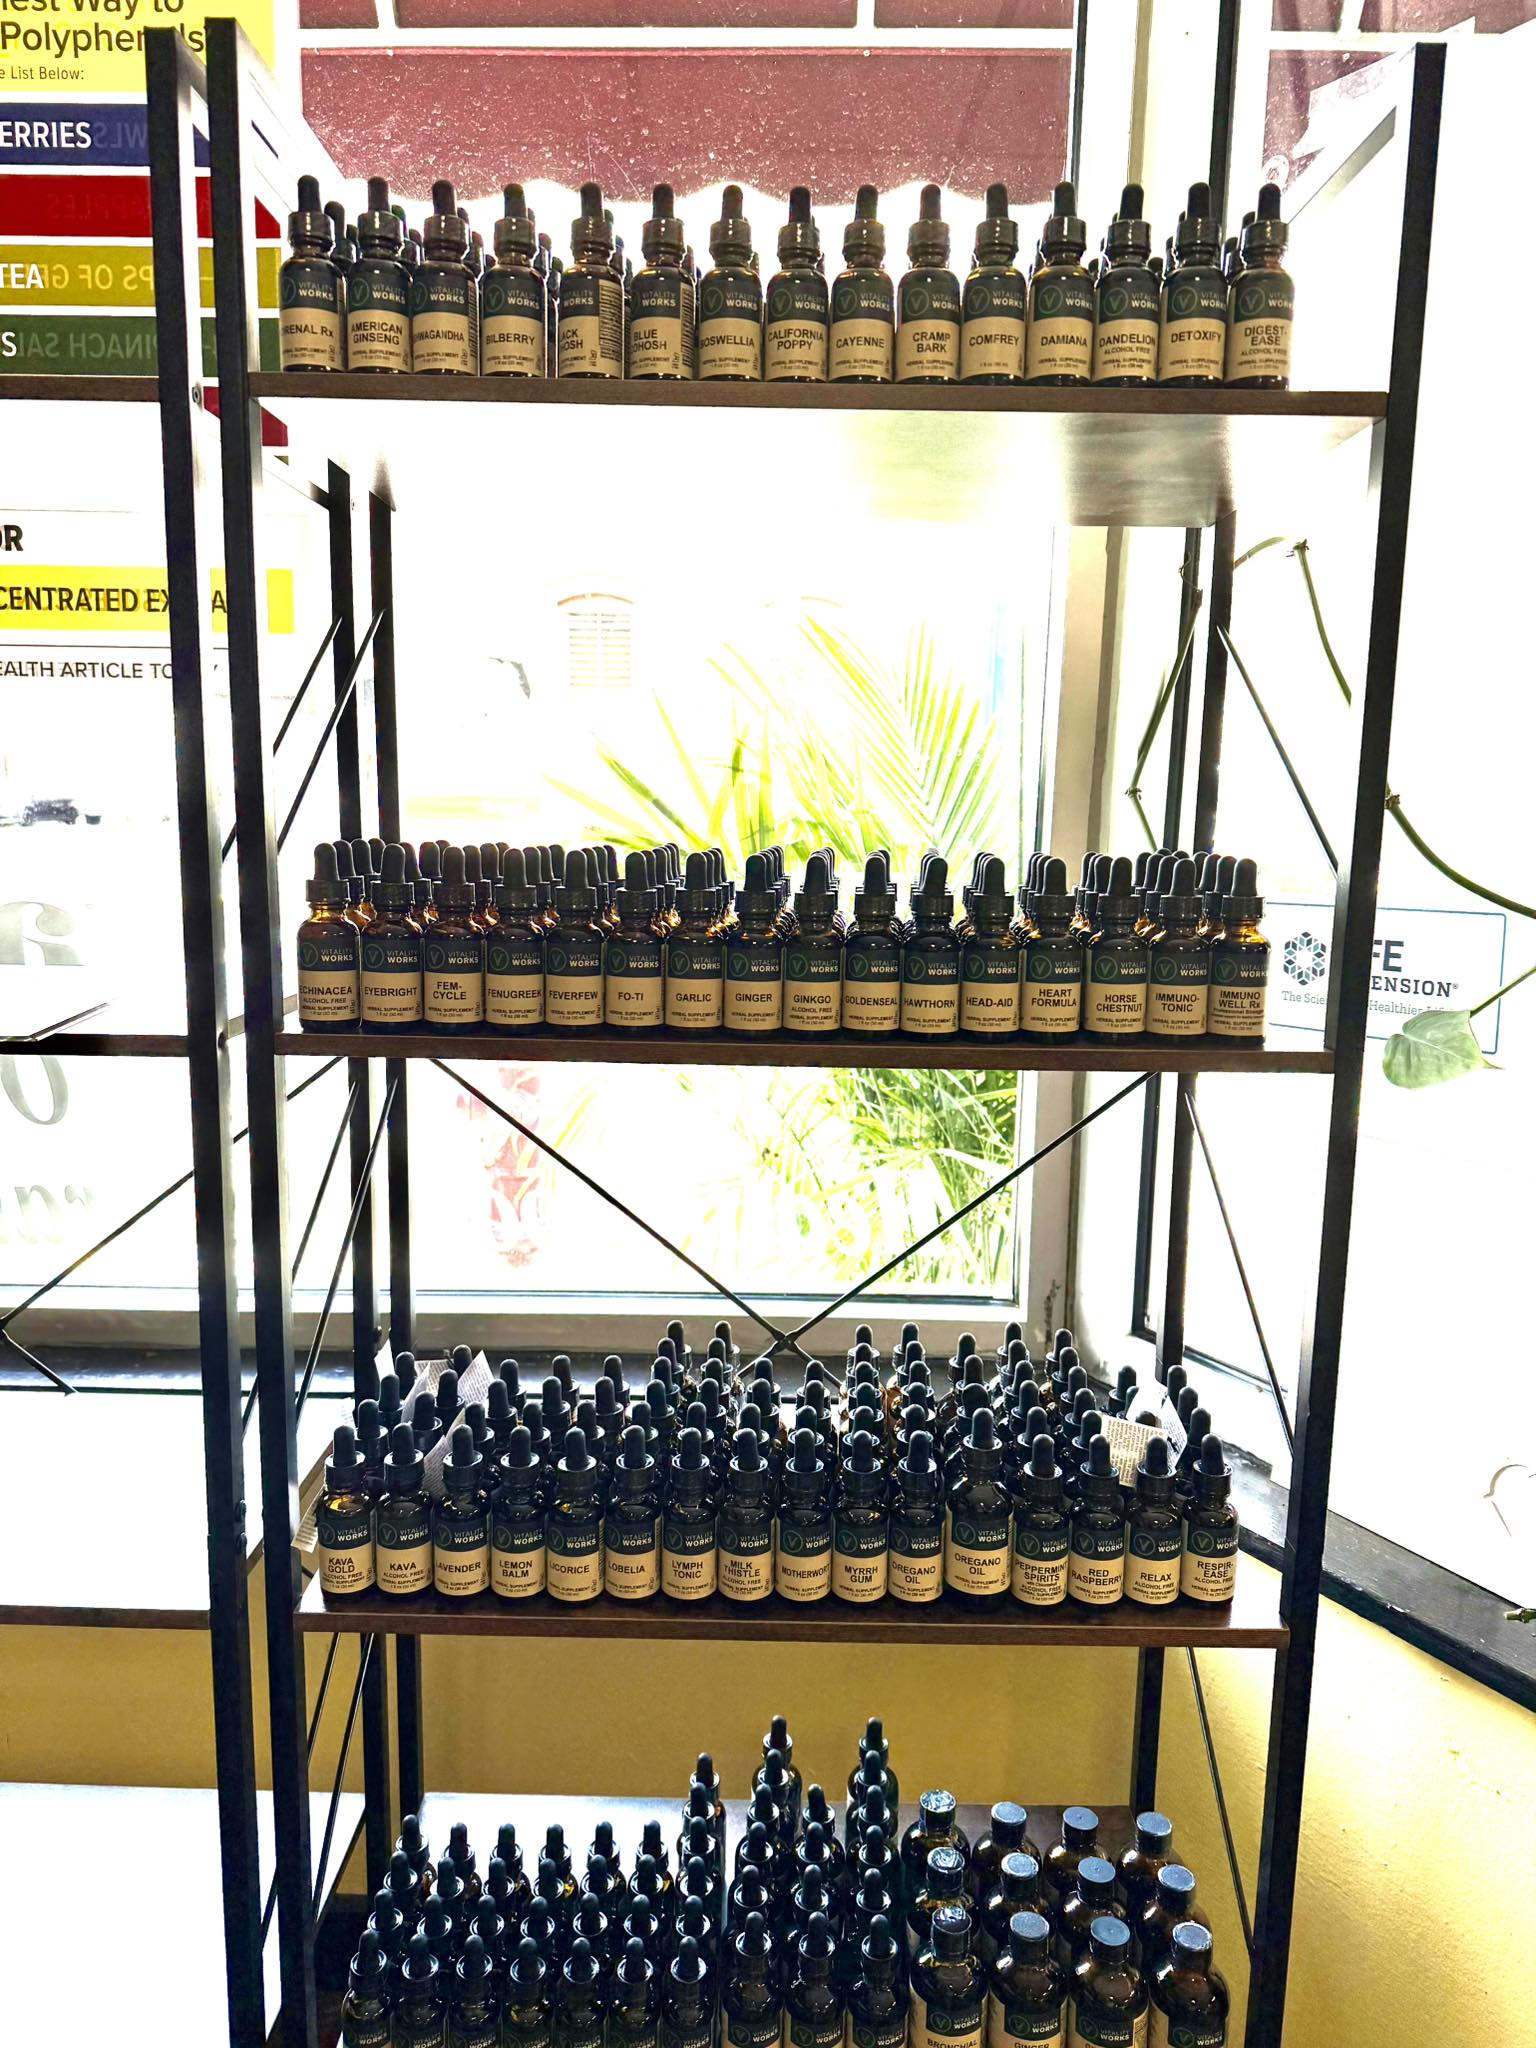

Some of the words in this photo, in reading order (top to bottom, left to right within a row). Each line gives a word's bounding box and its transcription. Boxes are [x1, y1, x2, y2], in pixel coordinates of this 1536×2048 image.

[1, 21, 205, 58] Polyphels
[11, 67, 34, 80] List
[40, 67, 84, 80] Below:
[299, 289, 333, 301] WORKS
[373, 292, 405, 304] WORKS
[430, 293, 465, 304] WORKS
[507, 297, 540, 310] WORKS
[563, 298, 594, 307] WORKS
[642, 298, 676, 307] WORKS
[726, 299, 757, 311] WORKS
[795, 301, 825, 313] WORKS
[860, 299, 890, 312] WORKS
[993, 298, 1023, 308] WORKS
[352, 322, 402, 336] AMERICAN
[1245, 325, 1287, 337] DIGEST-
[353, 333, 400, 346] GINSENG
[486, 333, 535, 346] BILBERRY
[634, 329, 658, 341] BLUE
[768, 329, 824, 341] CALIFORNIA
[913, 331, 951, 342] CRAMP
[969, 334, 1020, 346] COMFREY
[1100, 333, 1156, 347] DANDELION
[1171, 331, 1222, 344] DETOXIFY
[777, 340, 813, 350] POPPY
[836, 336, 885, 349] CAYENNE
[1041, 335, 1087, 346] DAMIANA
[1251, 336, 1281, 346] EASE
[917, 343, 947, 353] BARK
[61, 662, 143, 678] ARTICLE
[928, 968, 957, 976] WORKS
[300, 986, 352, 995] ECHINACEA
[437, 981, 462, 990] FEM-
[365, 987, 417, 997] EYEBRIGHT
[433, 991, 467, 1000] CYCLE
[488, 989, 542, 999] FENUGREEK
[550, 991, 598, 1000] FEVERFEW
[618, 992, 644, 1001] FO-TI
[1039, 988, 1072, 997] HEART
[1220, 991, 1261, 1000] IMMUNO
[1282, 991, 1301, 1003] The
[676, 993, 712, 1002] GARLIC
[735, 993, 772, 1002] GINGER
[793, 995, 832, 1004] GINKGO
[845, 995, 898, 1006] GOLDENSEAL
[1031, 998, 1077, 1007] FORMULA
[1105, 994, 1137, 1003] HORSE
[1155, 992, 1200, 1003] IMMUNO-
[903, 998, 955, 1008] HAWTHORN
[966, 998, 1013, 1008] HEAD-AID
[1096, 1003, 1143, 1013] CHESTNUT
[1162, 1003, 1193, 1012] TONIC
[1218, 999, 1246, 1008] WELL
[1249, 1000, 1261, 1008] Rx
[337, 1530, 368, 1541] WORKS
[400, 1529, 428, 1541] WORKS
[454, 1532, 484, 1544] WORKS
[514, 1534, 542, 1545] WORKS
[978, 1533, 1006, 1542] WORKS
[567, 1538, 596, 1549] WORKS
[622, 1537, 652, 1547] WORKS
[686, 1536, 713, 1547] WORKS
[740, 1538, 769, 1548] WORKS
[806, 1537, 830, 1549] WORKS
[860, 1539, 886, 1550] WORKS
[911, 1541, 939, 1550] WORKS
[1042, 1542, 1067, 1553] WORKS
[1097, 1543, 1123, 1552] WORKS
[328, 1557, 354, 1565] KAVA
[499, 1560, 533, 1569] LEMON
[730, 1560, 753, 1569] MILK
[954, 1553, 1001, 1566] OREGANO
[328, 1565, 355, 1574] GOLD
[390, 1562, 417, 1571] KAVA
[436, 1562, 481, 1573] LAVENDER
[608, 1561, 645, 1574] LOBELIA
[672, 1560, 703, 1570] LYMPH
[844, 1565, 878, 1574] MYRRH
[892, 1561, 936, 1574] OREGANO
[1015, 1558, 1068, 1575] PEPPERMINT
[1197, 1561, 1234, 1570] RESPIR-
[348, 1571, 363, 1579] FREE
[502, 1569, 529, 1578] BALM
[673, 1569, 702, 1579] TONIC
[724, 1565, 760, 1577] THISTLE
[782, 1563, 830, 1578] MOTHERWORT
[969, 1567, 986, 1575] OIL
[1088, 1569, 1109, 1577] RED
[1203, 1569, 1229, 1579] EASE
[850, 1575, 873, 1583] GUM
[905, 1575, 920, 1584] OIL
[1024, 1572, 1060, 1582] SPIRITS
[1071, 1570, 1122, 1586] RASPBERRY
[1140, 1572, 1172, 1582] RELAX
[1134, 1581, 1162, 1589] ALCOHOL
[954, 2017, 979, 2029] WORKS
